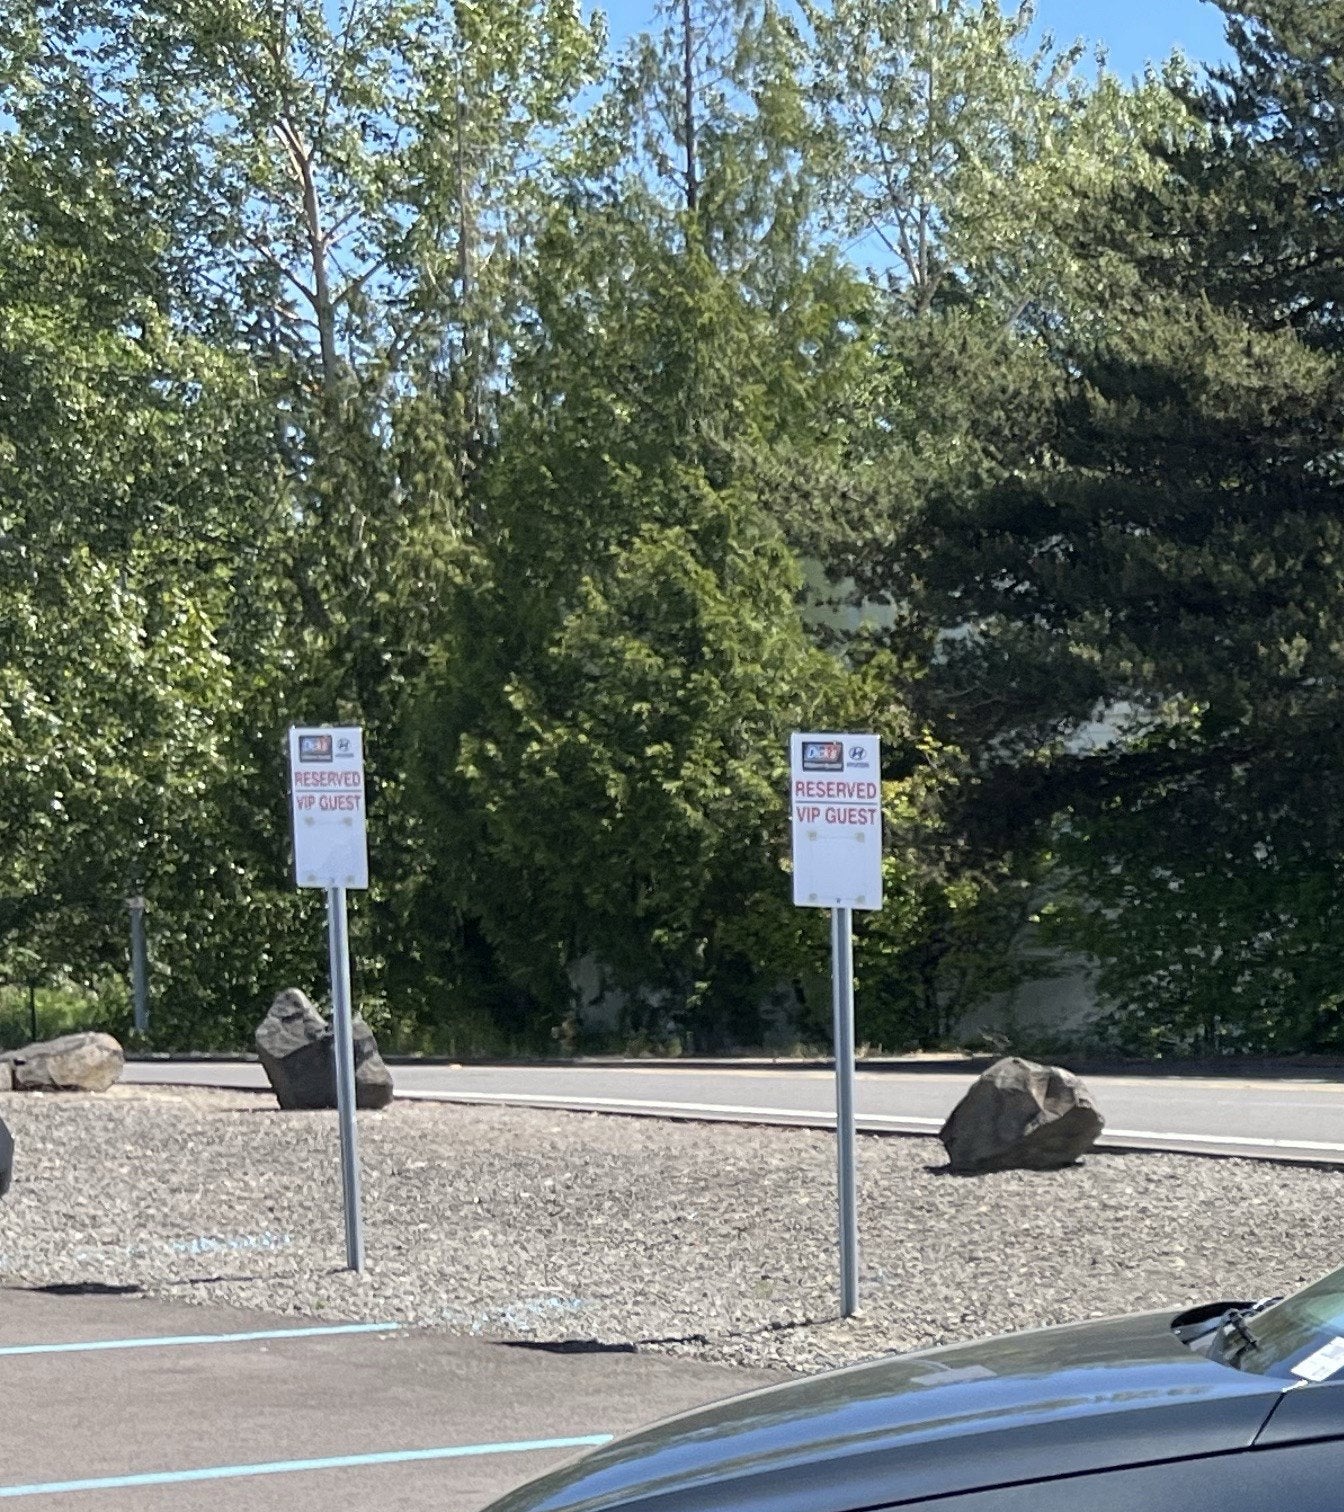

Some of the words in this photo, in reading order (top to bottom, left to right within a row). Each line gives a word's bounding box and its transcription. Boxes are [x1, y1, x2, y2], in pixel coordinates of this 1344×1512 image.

[294, 771, 361, 787] RESERVED
[795, 781, 877, 800] RESERVED
[296, 795, 316, 810] VIP
[319, 795, 361, 811] GUEST
[796, 807, 820, 823] VIP
[825, 807, 877, 825] GUEST
